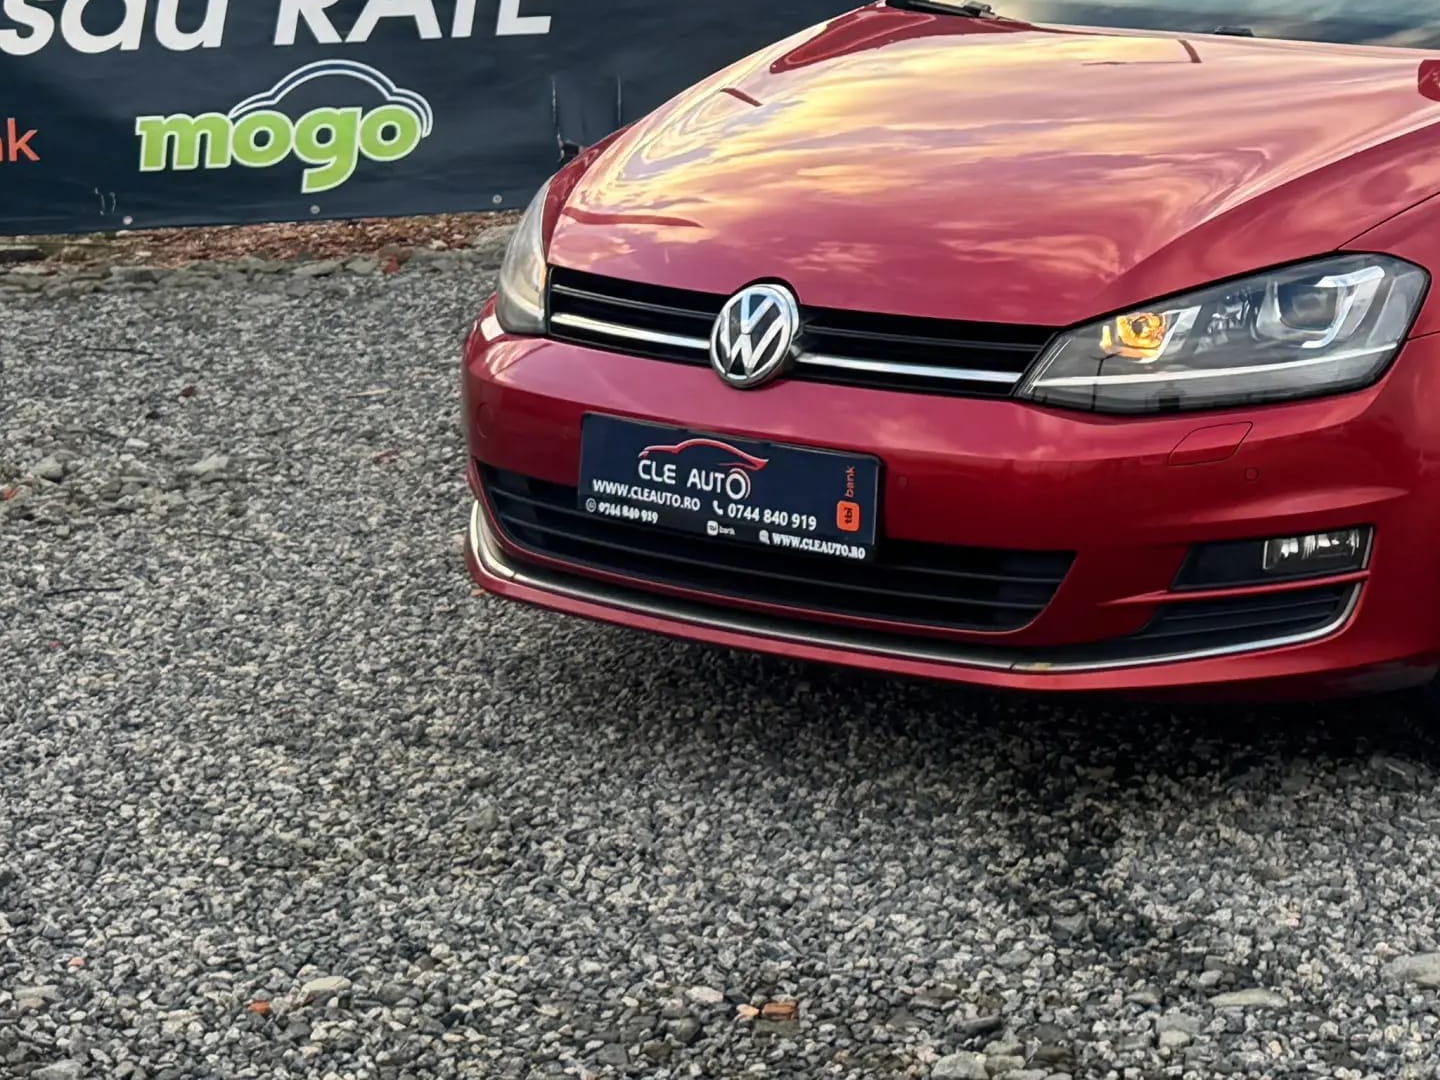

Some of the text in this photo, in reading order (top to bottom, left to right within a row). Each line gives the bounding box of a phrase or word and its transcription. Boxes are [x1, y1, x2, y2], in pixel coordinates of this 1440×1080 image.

[136, 104, 424, 193] mogo
[592, 479, 701, 511] WWW.CLEAUTO.RO
[638, 459, 748, 500] CLE AUTO
[844, 466, 856, 497] bank
[598, 502, 621, 517] 0744
[641, 510, 659, 524] 919
[727, 503, 817, 531] 0744 840 919
[772, 532, 866, 560] WWW.CLEAUTO.RO
